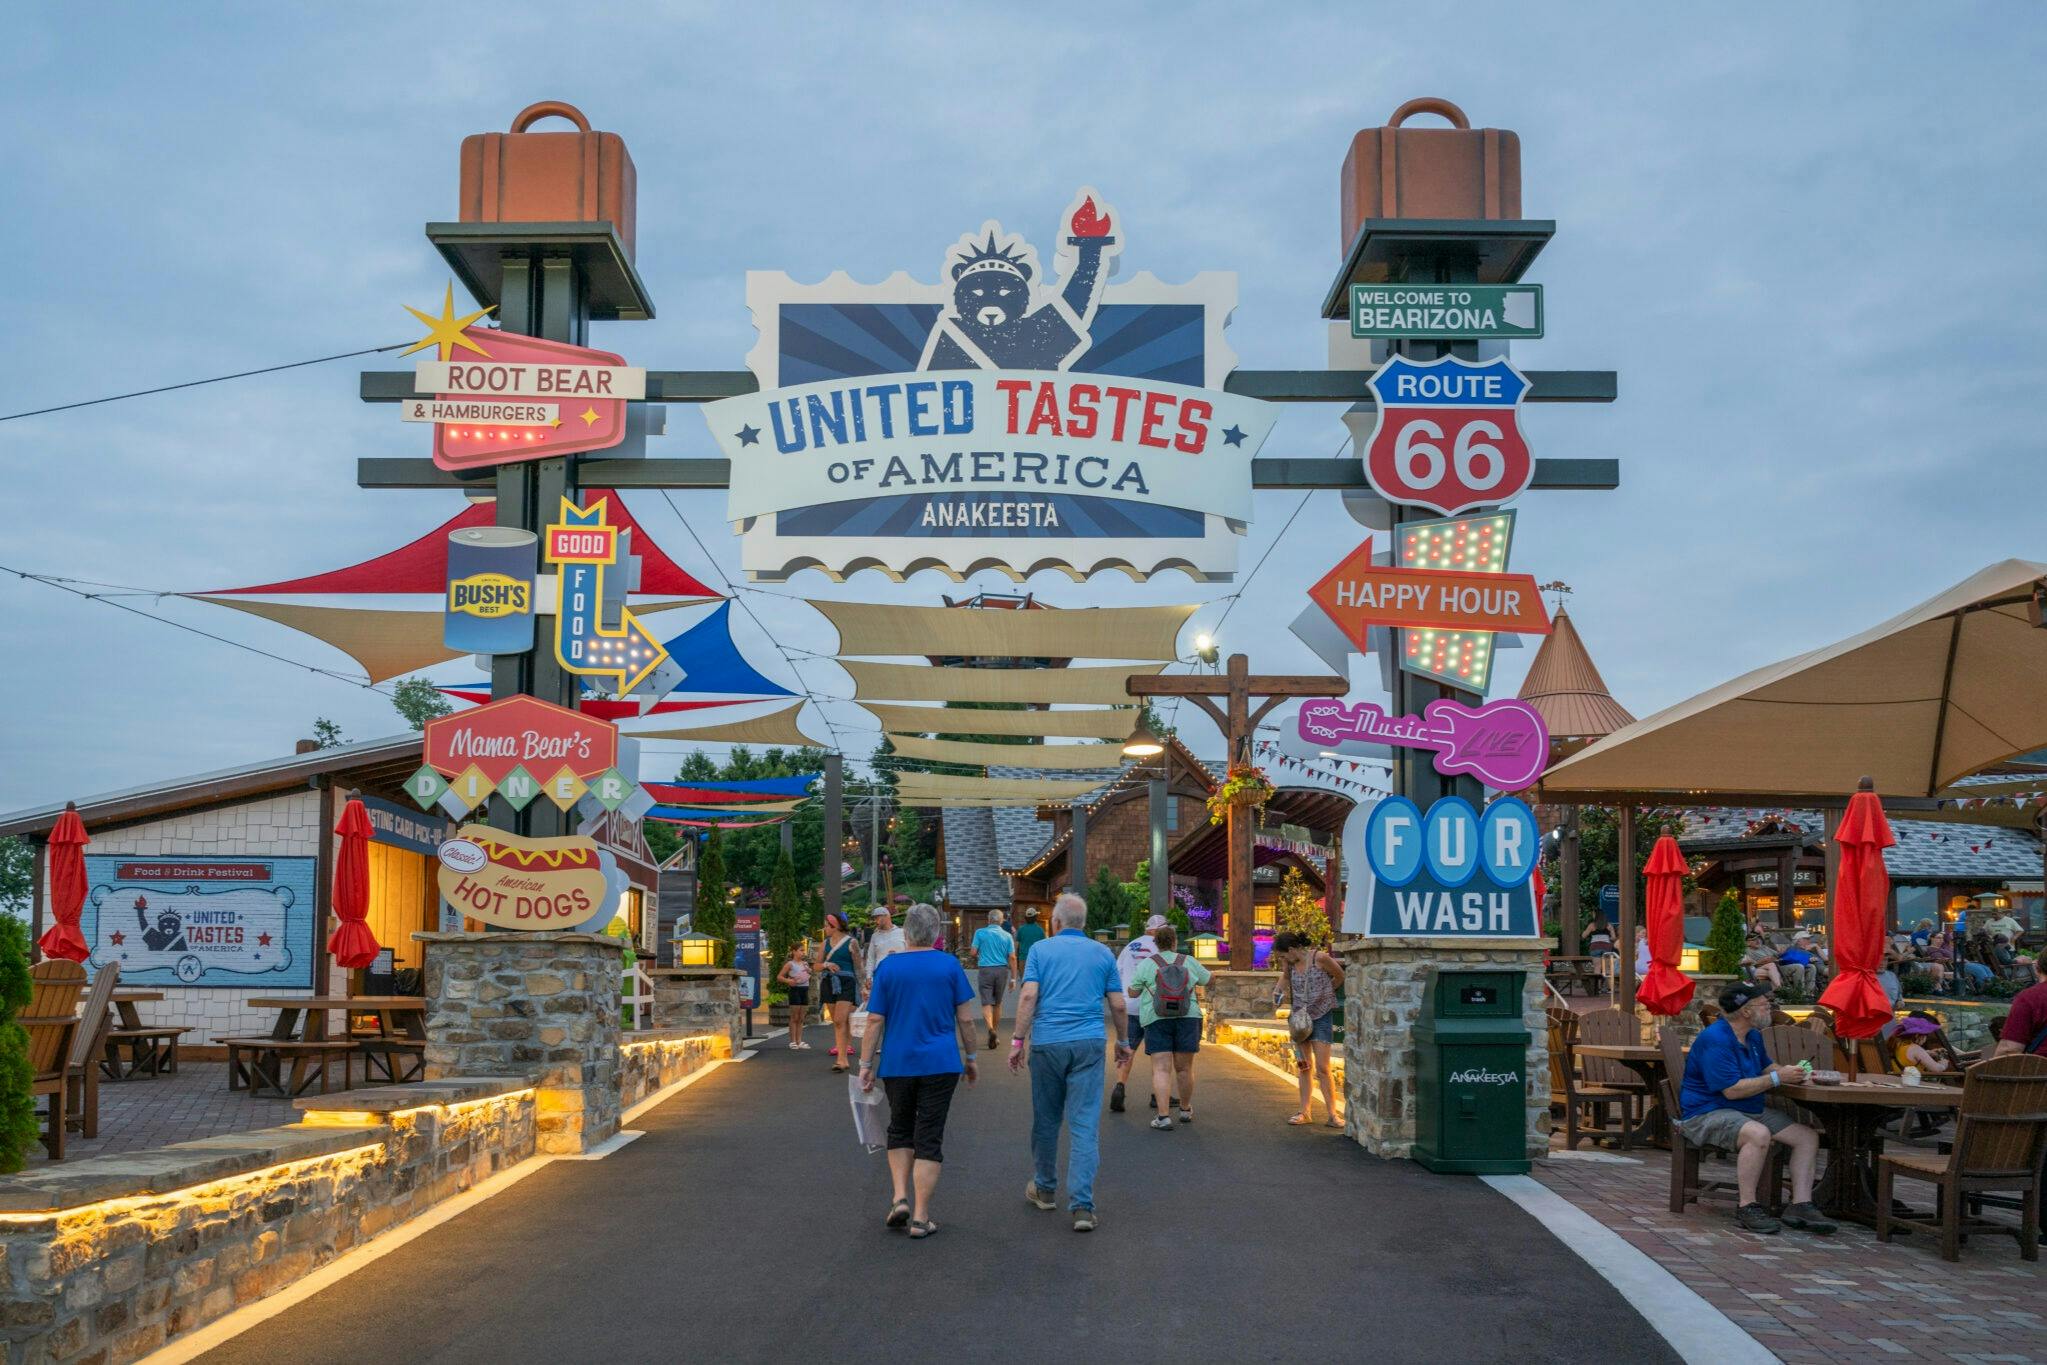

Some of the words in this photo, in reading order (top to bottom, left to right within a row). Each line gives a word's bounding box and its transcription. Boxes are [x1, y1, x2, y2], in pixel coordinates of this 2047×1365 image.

[1358, 292, 1444, 305] WELCOME
[1448, 292, 1472, 305] TO
[1359, 308, 1498, 330] BEARIZONA
[448, 365, 526, 391] ROOT
[537, 368, 613, 394] BEAR
[1397, 374, 1503, 398] ROUTE
[414, 404, 426, 418] &
[432, 404, 546, 422] HAMBURGERS
[768, 380, 974, 455] UNITED
[997, 380, 1213, 455] TASTES
[1394, 419, 1505, 490] 66
[828, 458, 875, 484] OF
[879, 452, 1150, 494] AMERICA
[922, 502, 1060, 528] ANAKEESTA
[558, 535, 604, 554] GOOD
[455, 584, 526, 608] BUSH'S
[1336, 581, 1431, 611] HAPPY
[1439, 587, 1521, 616] HOUR
[571, 569, 587, 659] FOOD
[1354, 709, 1429, 741] Music
[449, 727, 518, 758] Mama
[522, 730, 592, 760] Bear's
[1460, 727, 1535, 758] LIVE!
[417, 775, 622, 800] DINER
[365, 807, 393, 832] STING
[1384, 817, 1523, 867] FUR
[443, 848, 482, 864] Classic!
[134, 868, 161, 876] Food
[173, 868, 205, 876] Drink
[208, 868, 254, 877] Festival
[496, 875, 546, 893] American
[1751, 873, 1772, 882] TAP
[454, 876, 508, 915] HOT
[516, 888, 590, 919] DOGS
[193, 911, 235, 924] UNITED
[1395, 892, 1510, 931] WASH
[186, 926, 244, 943] TASTES
[1449, 1067, 1519, 1086] ANAKEESTA
